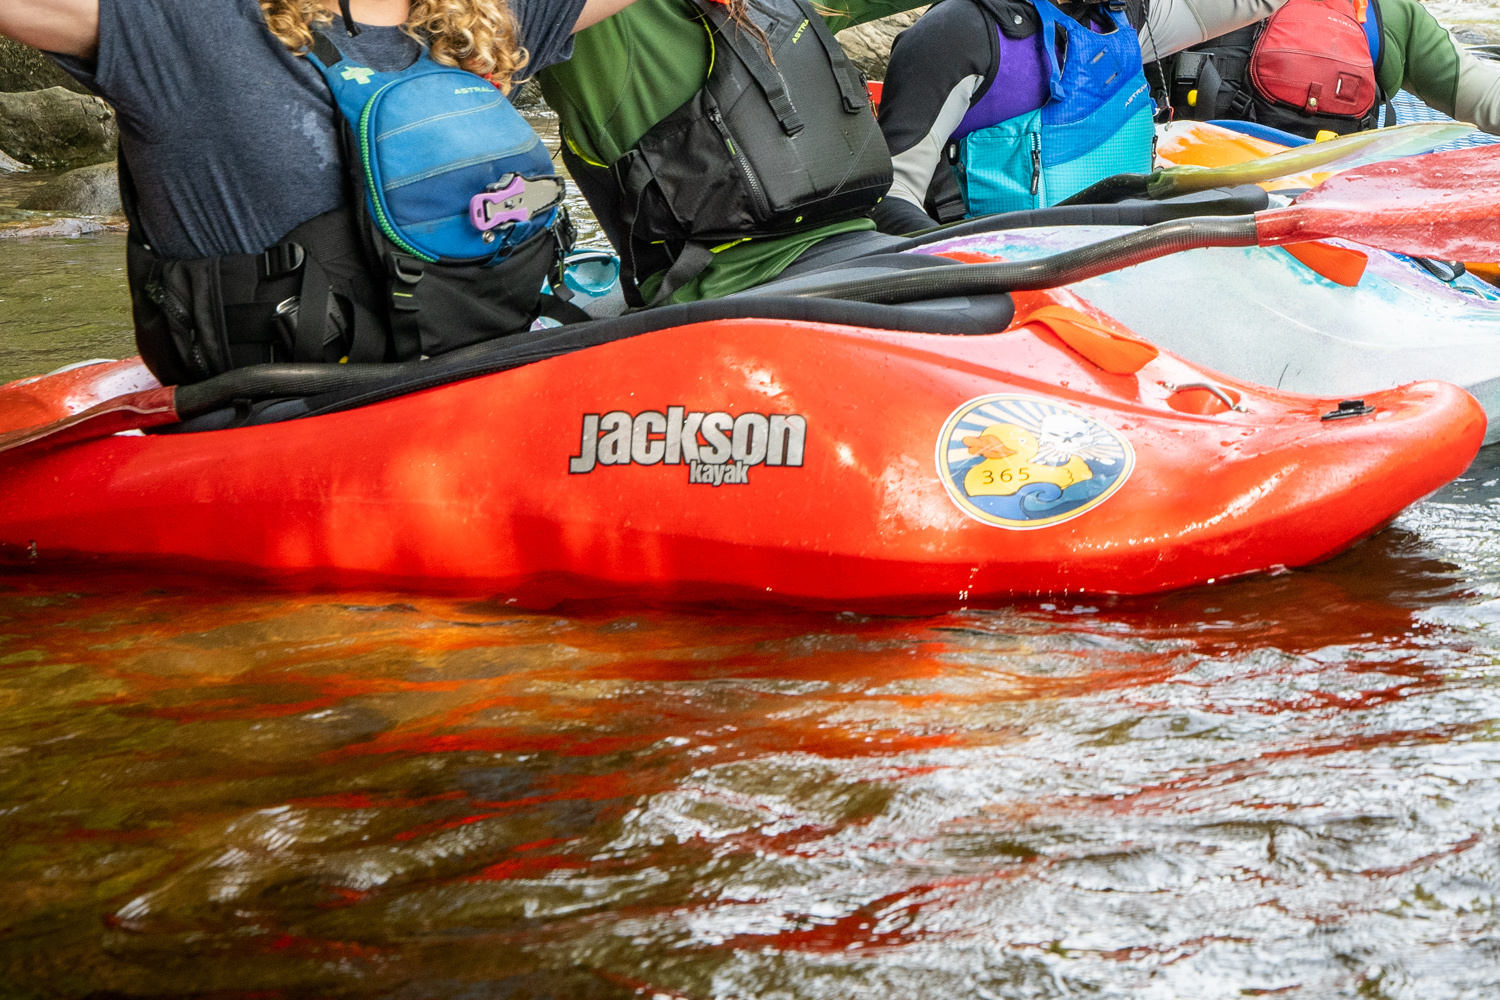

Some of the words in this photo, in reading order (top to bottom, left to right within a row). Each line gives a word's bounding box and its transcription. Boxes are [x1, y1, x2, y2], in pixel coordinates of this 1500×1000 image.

[792, 19, 810, 44] ASTRA
[1327, 16, 1359, 32] ASTRAL
[454, 86, 496, 95] ASTRAL
[568, 405, 808, 473] jackson
[688, 459, 750, 487] kayak
[982, 468, 1030, 485] 365
